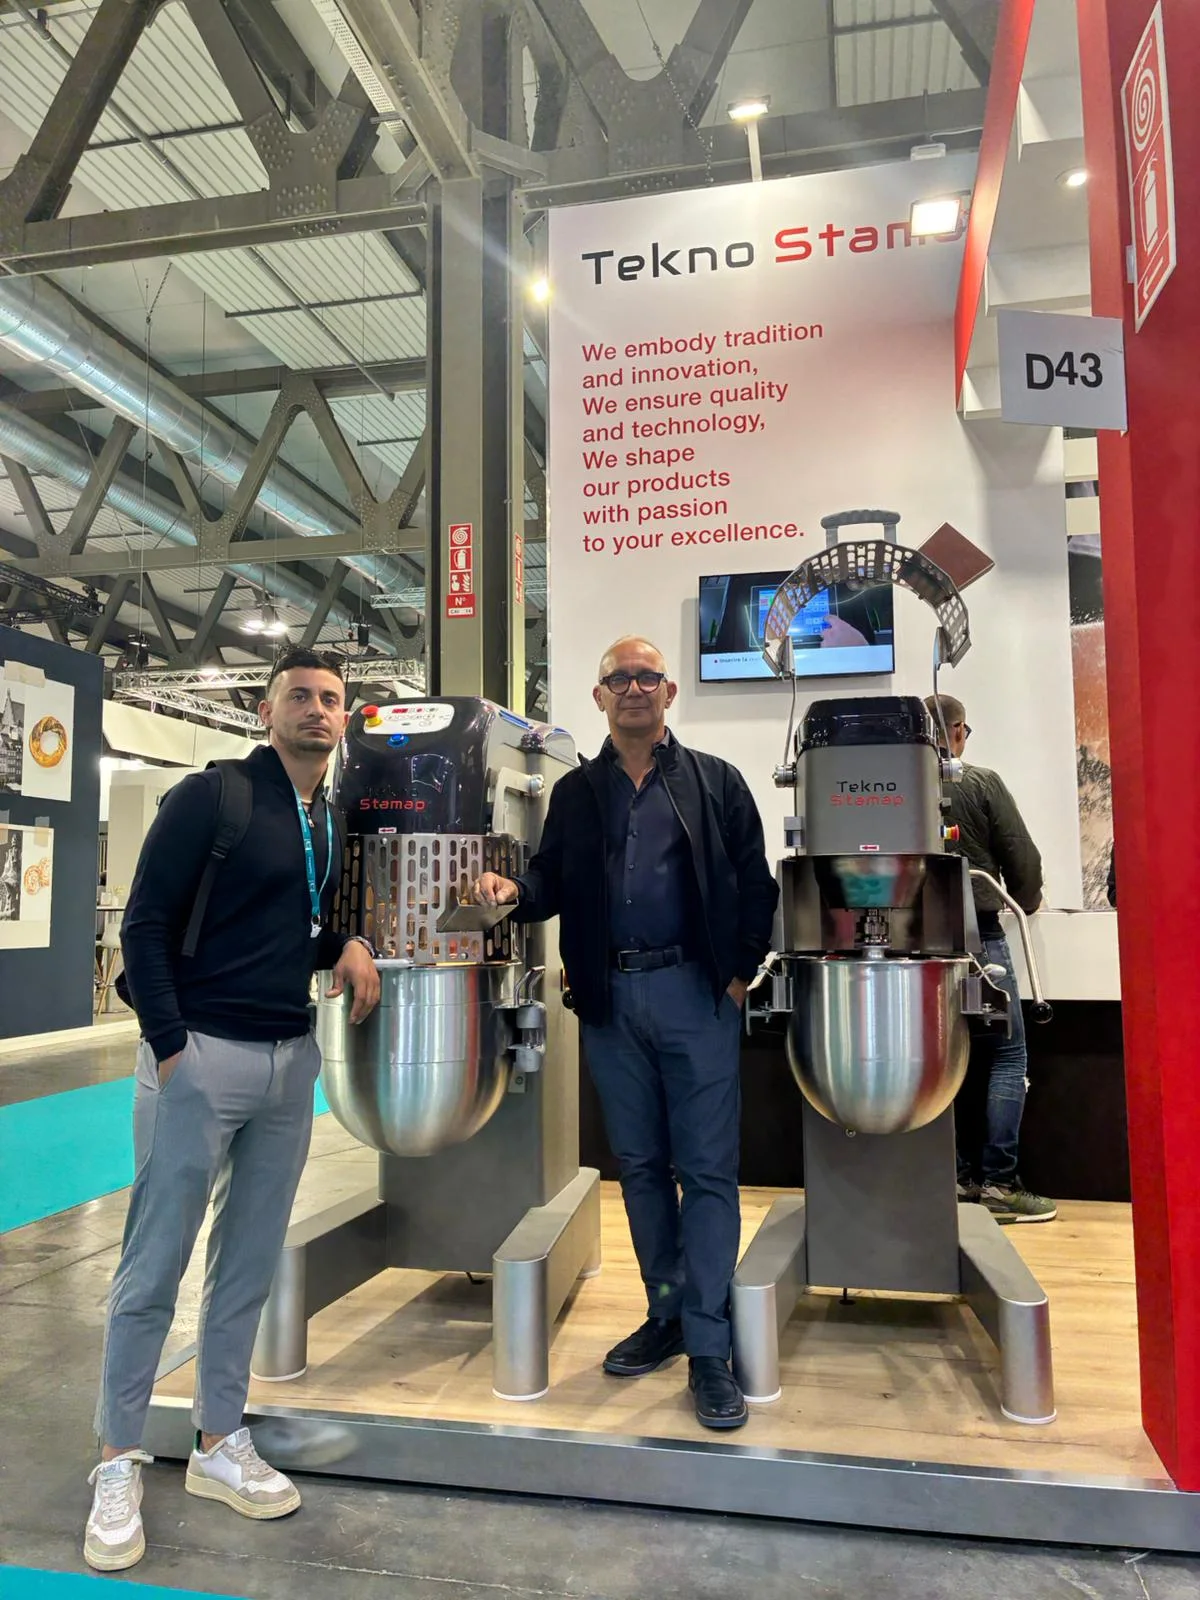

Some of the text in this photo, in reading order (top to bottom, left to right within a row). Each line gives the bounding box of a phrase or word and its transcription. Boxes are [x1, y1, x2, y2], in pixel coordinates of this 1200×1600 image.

[582, 242, 754, 284] Tekno
[583, 323, 824, 361] We embody tradition
[583, 356, 759, 389] and innovation,
[1026, 351, 1103, 390] D43
[583, 379, 789, 416] We ensure quality
[583, 413, 766, 443] and technology,
[583, 446, 695, 470] We shape
[583, 469, 731, 498] our products
[584, 498, 729, 526] with passion
[584, 523, 805, 557] to your excellence.
[830, 794, 904, 807] Stamap
[836, 780, 897, 793] Tekno
[360, 798, 426, 812] Stamap
